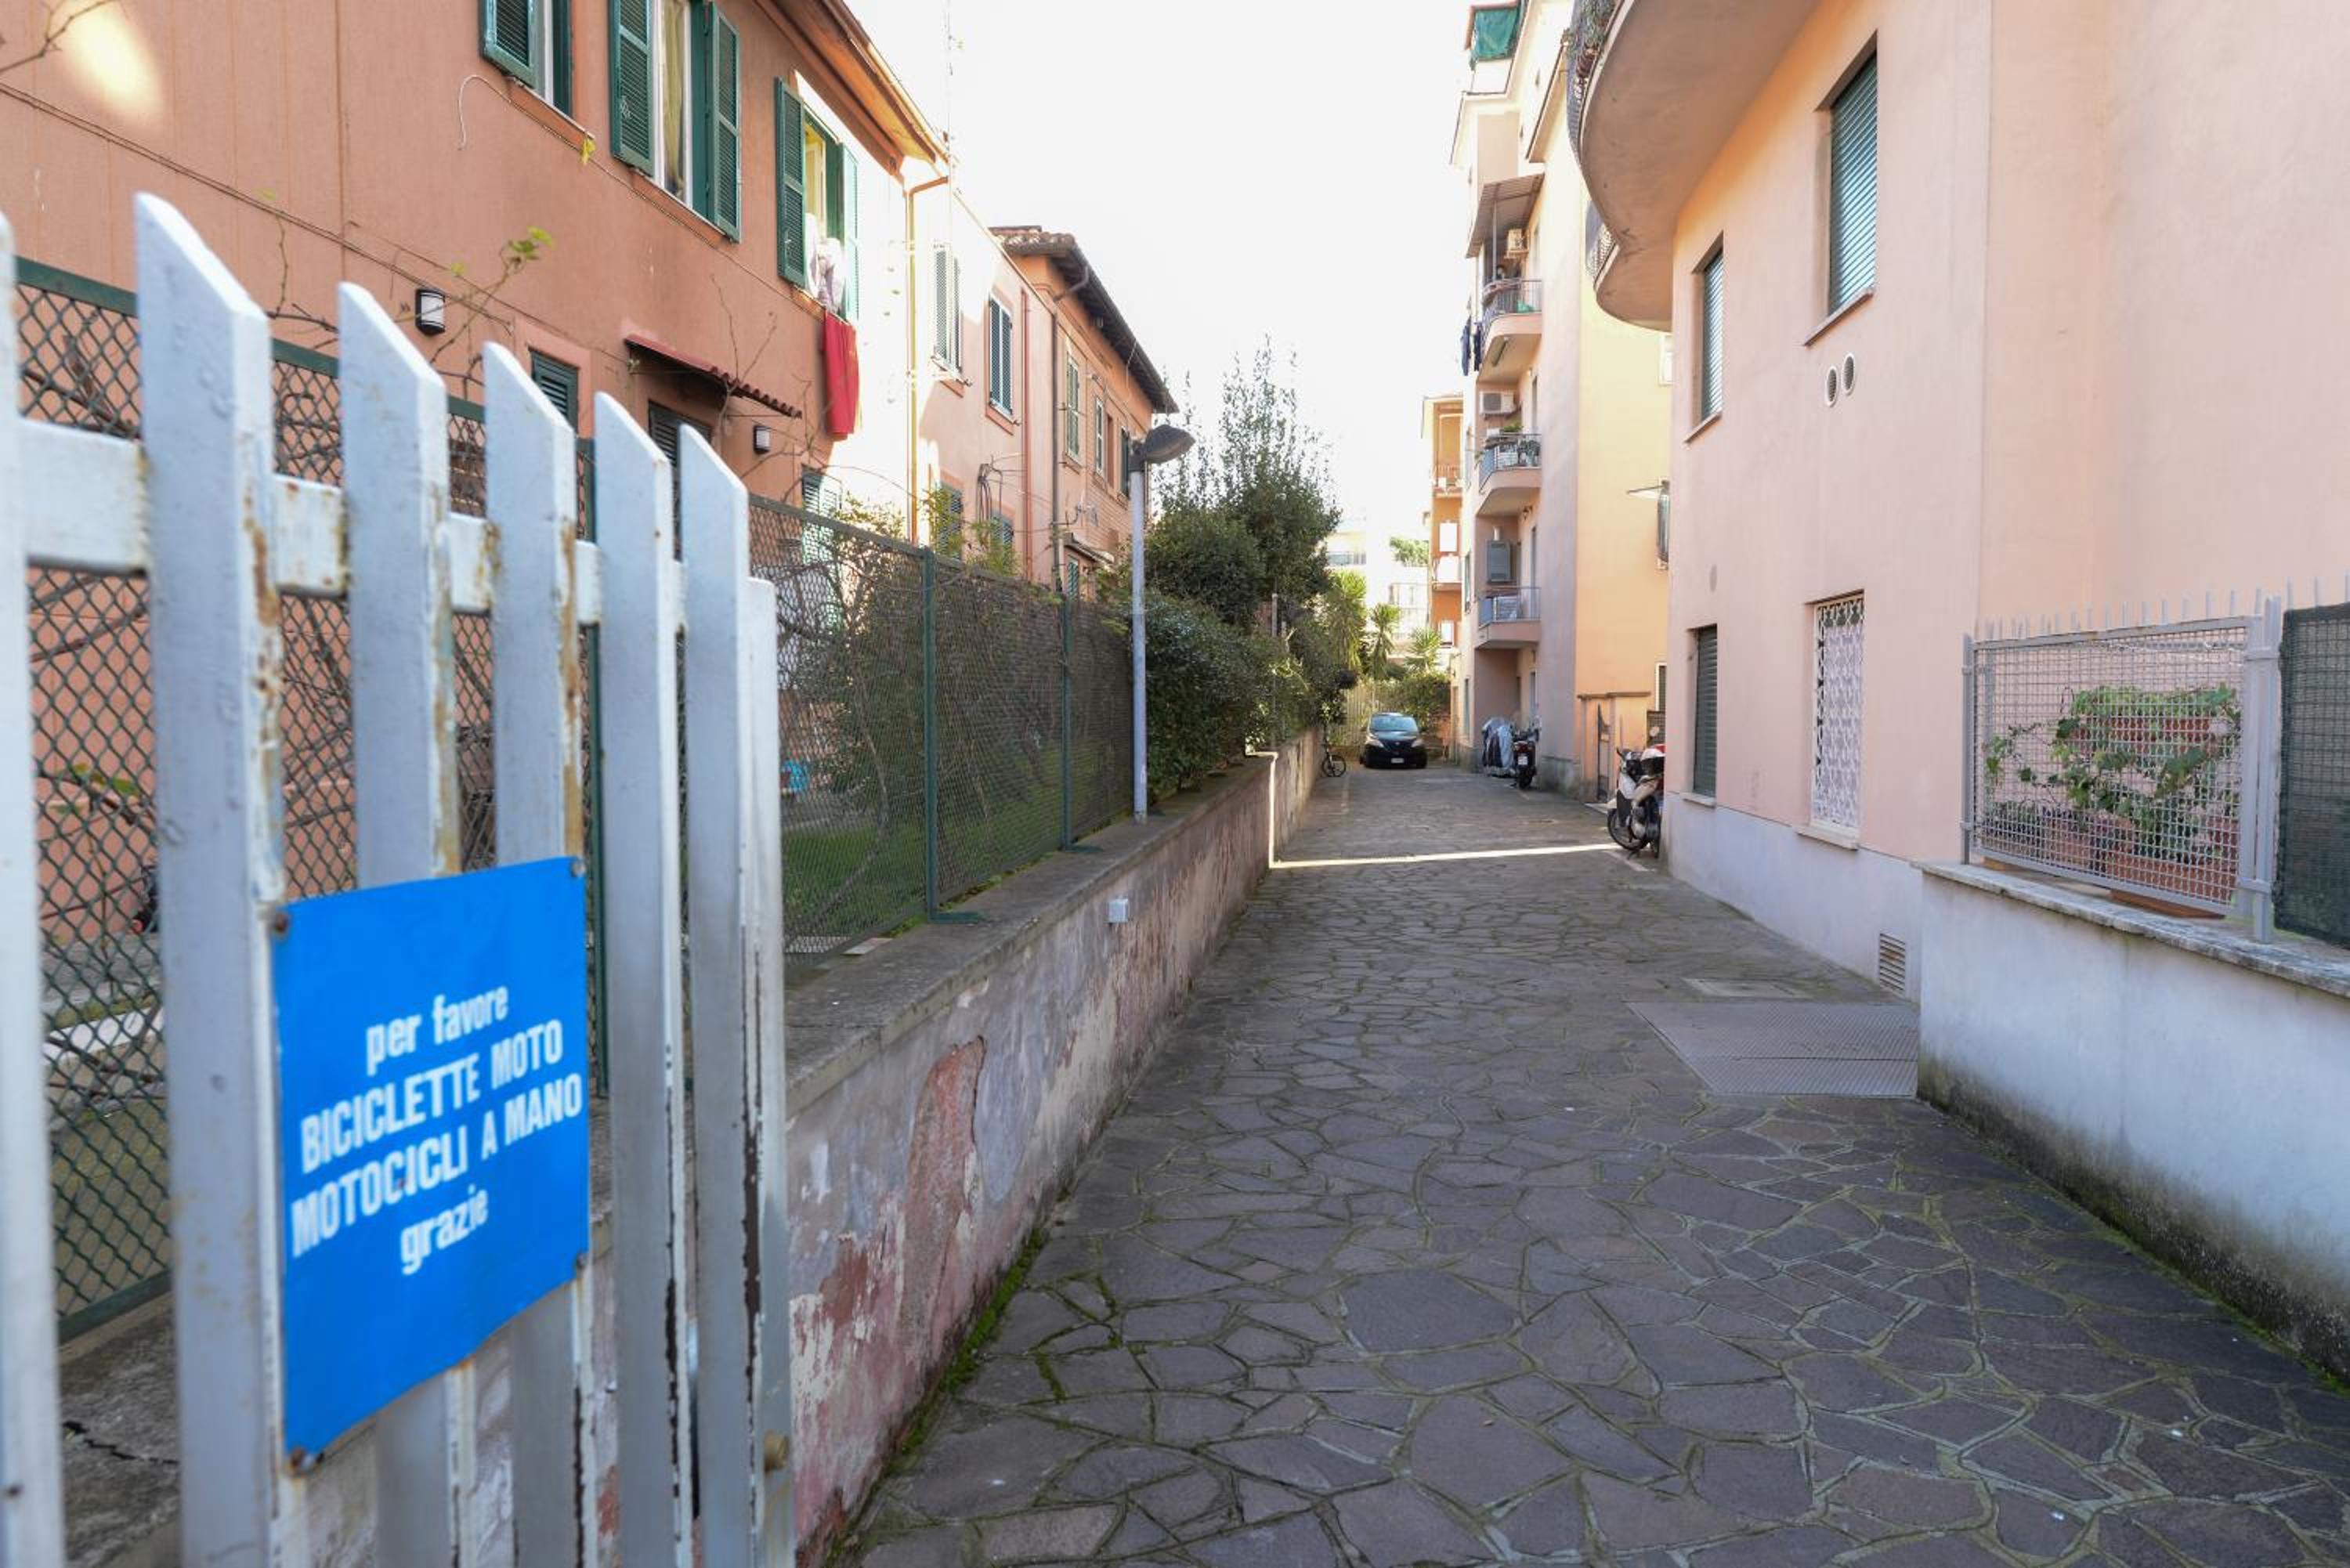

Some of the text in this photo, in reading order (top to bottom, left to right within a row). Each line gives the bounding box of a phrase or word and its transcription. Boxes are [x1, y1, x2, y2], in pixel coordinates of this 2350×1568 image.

[367, 986, 508, 1076] per favore
[301, 1019, 563, 1173] BICICLETTE MOTO
[291, 1073, 582, 1257] MOTOCICLI A MANO
[400, 1183, 488, 1275] grazie
